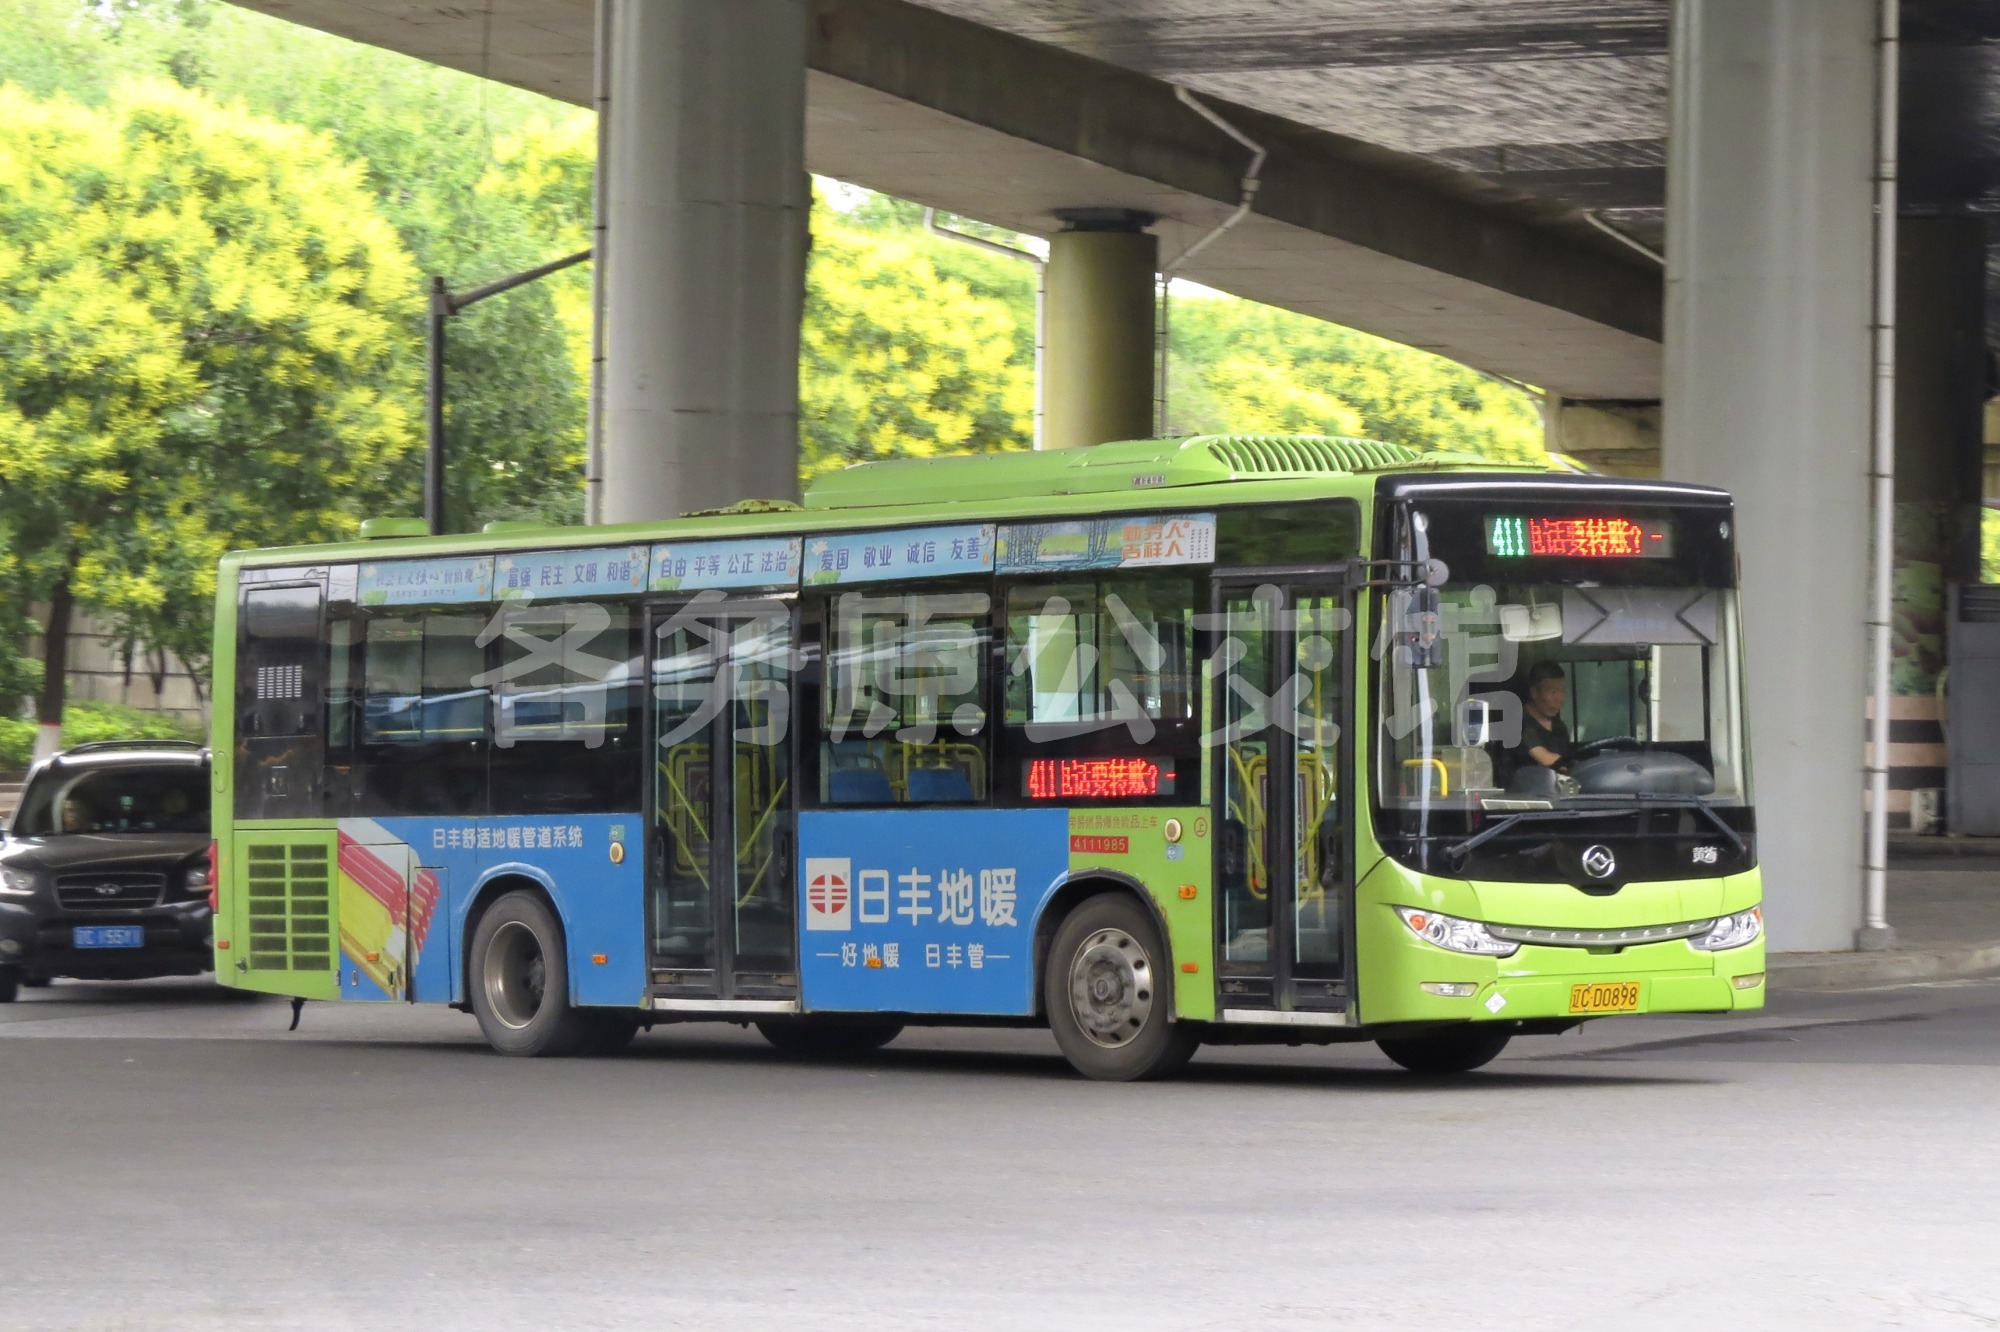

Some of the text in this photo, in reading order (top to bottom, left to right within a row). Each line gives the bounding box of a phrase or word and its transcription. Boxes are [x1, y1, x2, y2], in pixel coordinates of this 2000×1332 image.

[1493, 518, 1525, 556] 411
[661, 550, 788, 578] 自由 平等 公正 法治
[821, 537, 980, 571] 爱国 敬业 诚信 友善
[508, 560, 632, 588] 富强 民主 文明 和谐
[1029, 759, 1057, 798] 411
[432, 825, 583, 850] 日丰舒适地暖管道系统
[1074, 837, 1126, 851] 4111985
[858, 867, 1018, 927] 日丰地暖
[841, 942, 984, 969] 好地暖 日丰管
